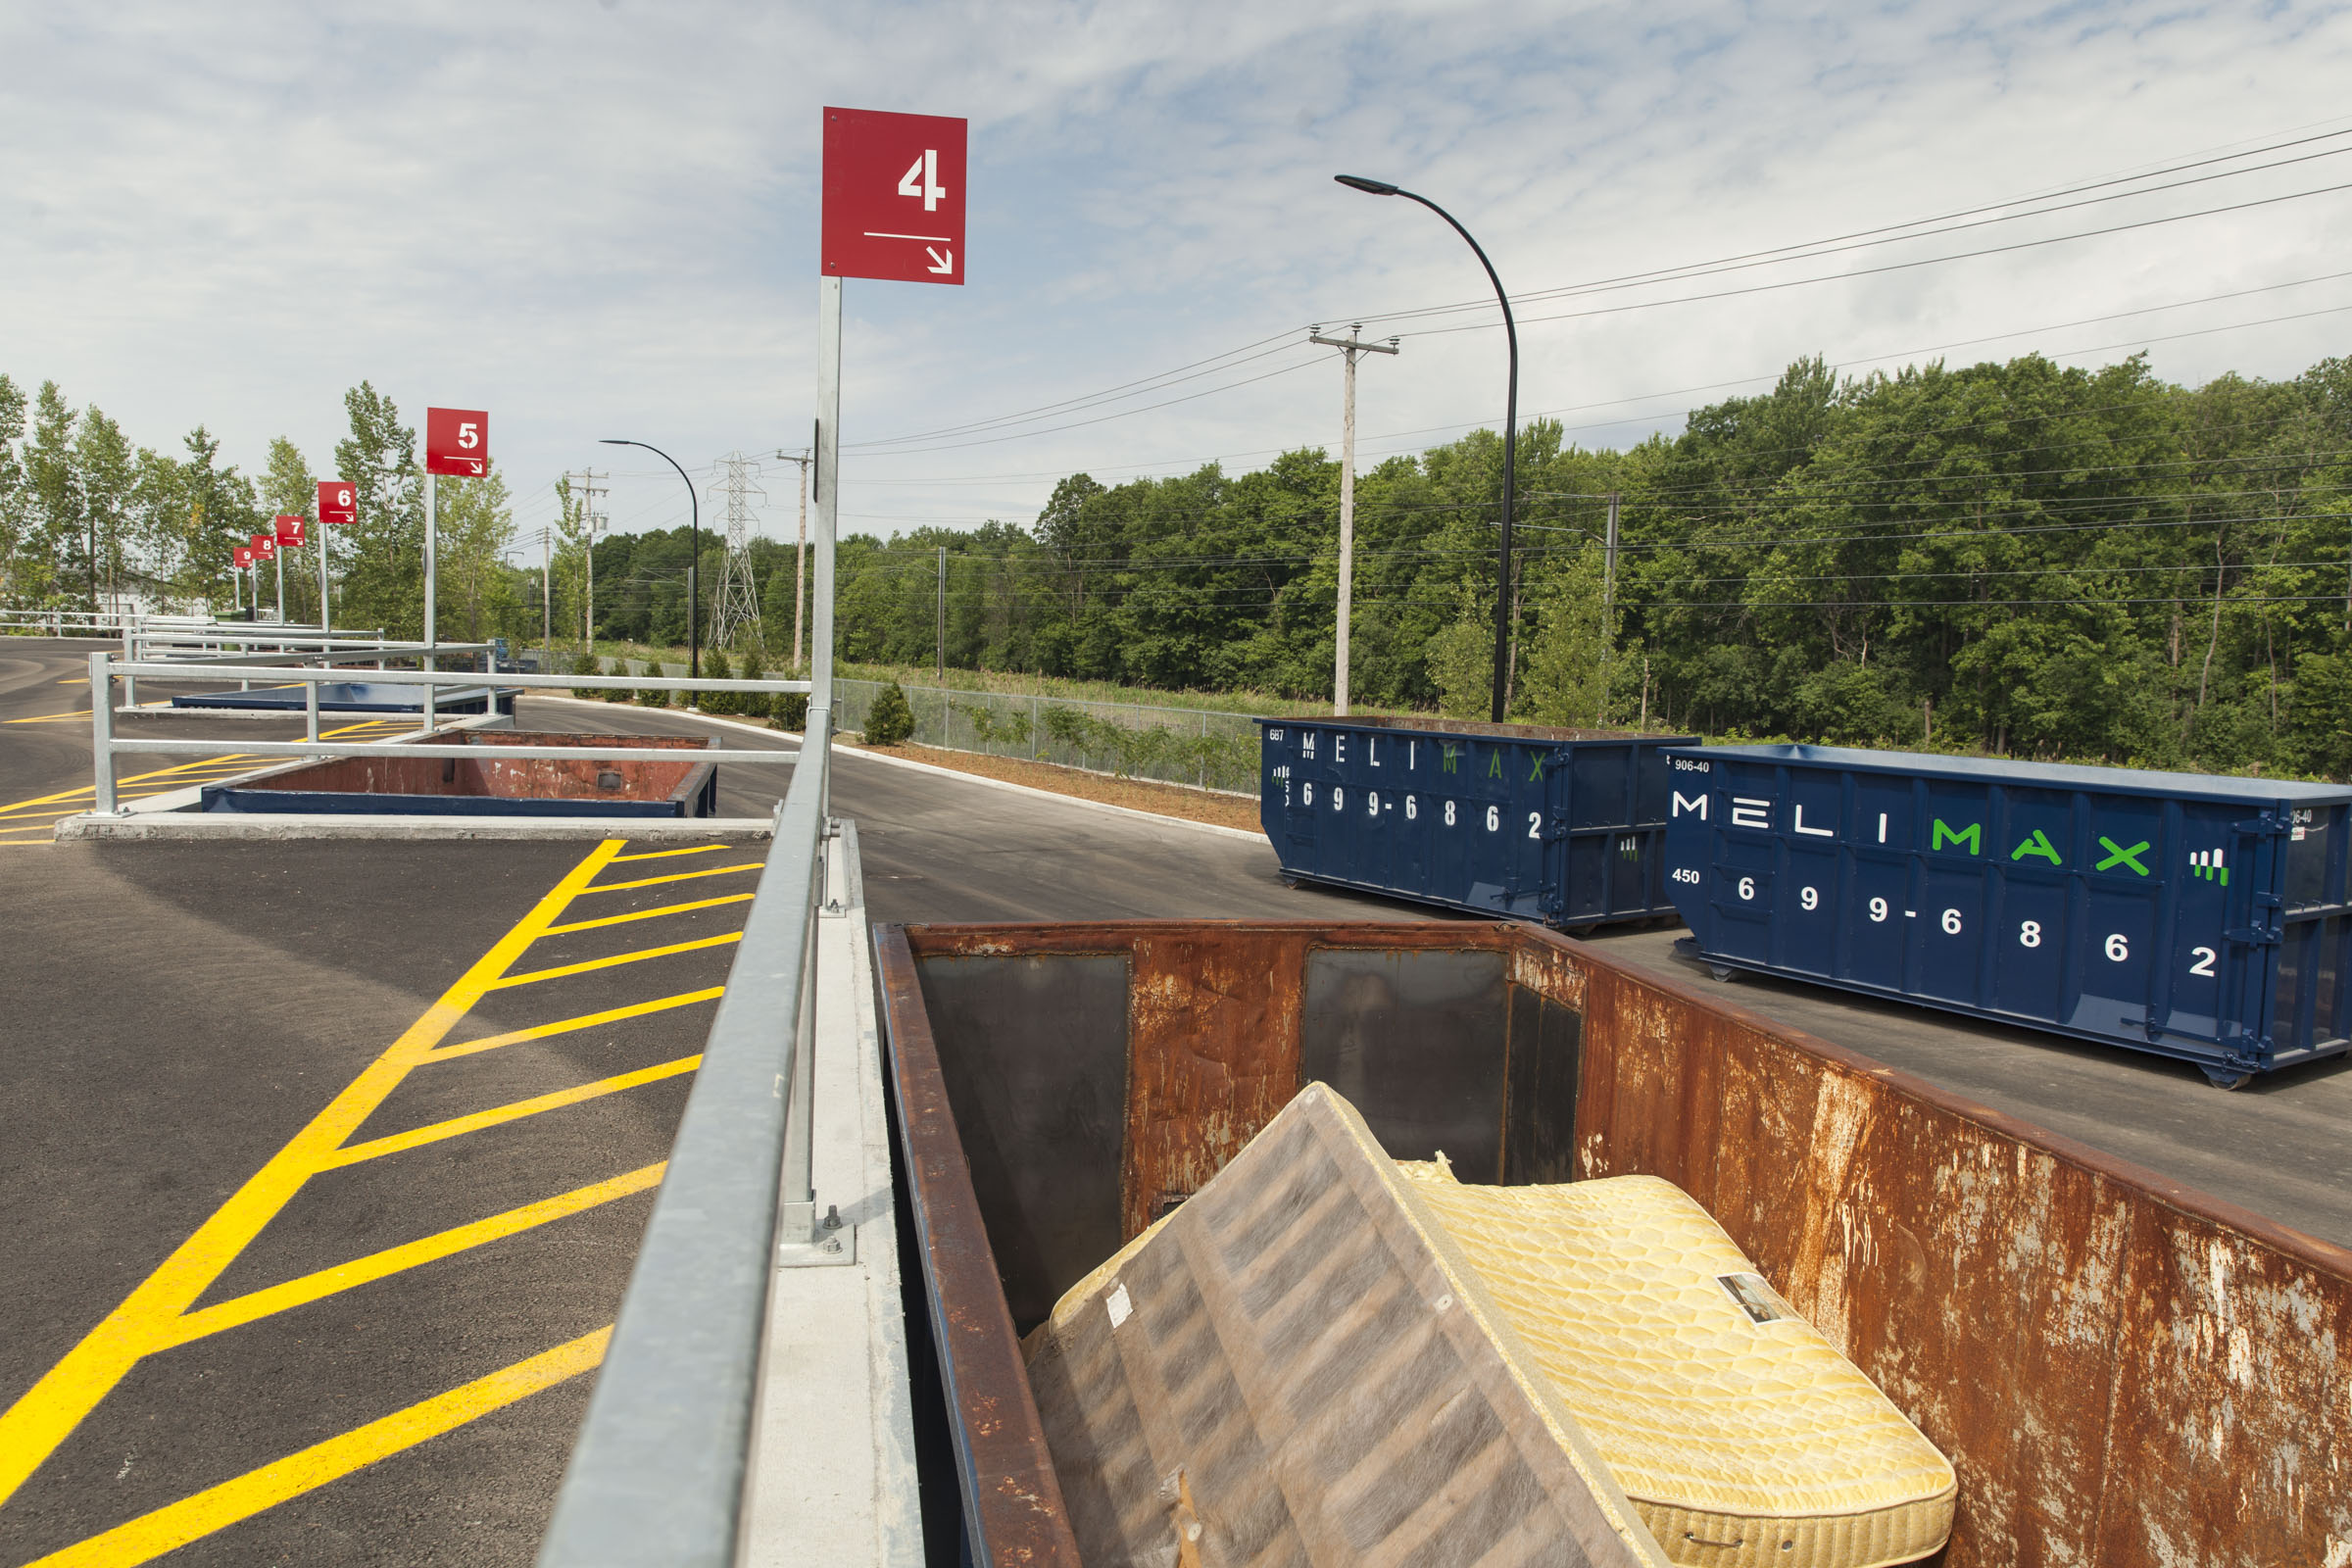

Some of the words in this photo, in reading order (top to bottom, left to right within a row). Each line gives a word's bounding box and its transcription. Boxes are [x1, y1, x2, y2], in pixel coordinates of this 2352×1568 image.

[898, 149, 946, 212] 4
[458, 422, 479, 449] 5
[337, 489, 352, 507] 6
[291, 521, 301, 534] 7
[263, 540, 271, 551] 8
[243, 551, 251, 560] 9
[1270, 729, 1284, 741] 687
[1675, 759, 1709, 773] 906-40
[1303, 782, 1542, 839] 699-6862
[1672, 790, 2150, 876] MELIMAX
[1672, 868, 1700, 884] 450
[1718, 877, 2216, 977] 699-6862
